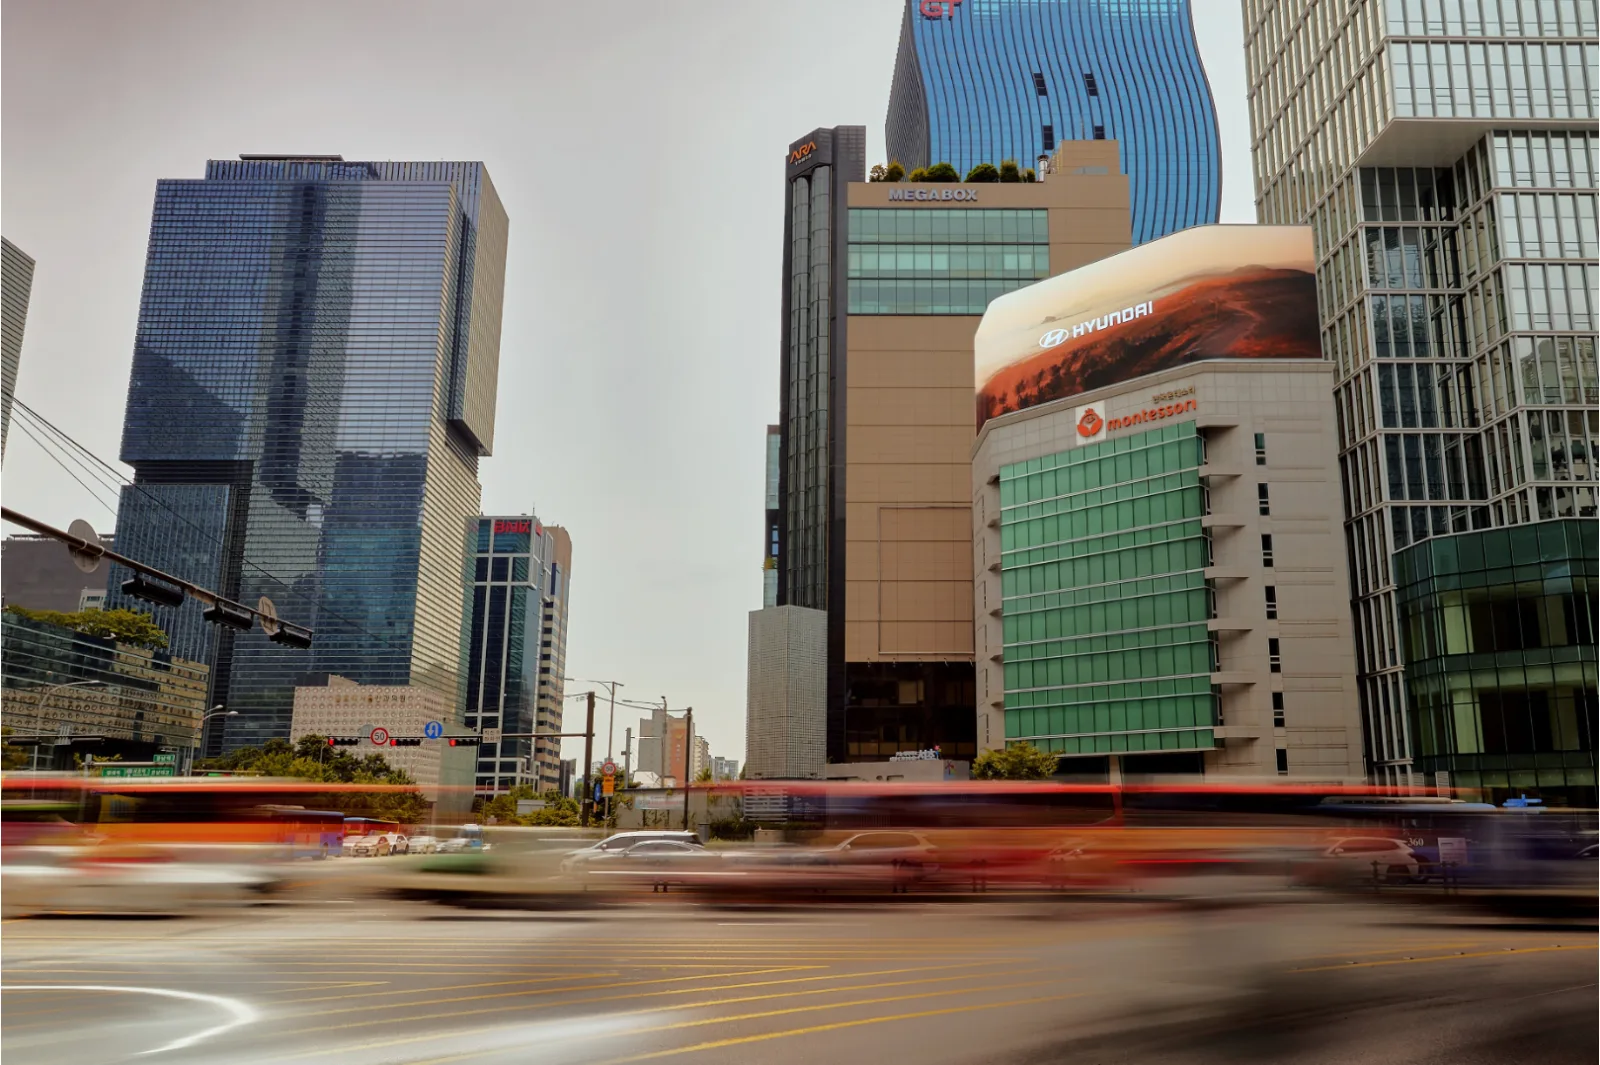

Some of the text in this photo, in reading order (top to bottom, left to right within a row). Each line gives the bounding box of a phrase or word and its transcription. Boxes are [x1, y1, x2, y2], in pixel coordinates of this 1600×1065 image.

[920, 0, 963, 18] GT
[790, 141, 817, 164] ARA
[889, 187, 978, 201] MEGABOX
[1072, 300, 1153, 338] HYUNDAI
[1107, 399, 1197, 432] montessori
[494, 520, 530, 533] BNK
[374, 731, 385, 741] 50
[1407, 837, 1424, 847] 360
